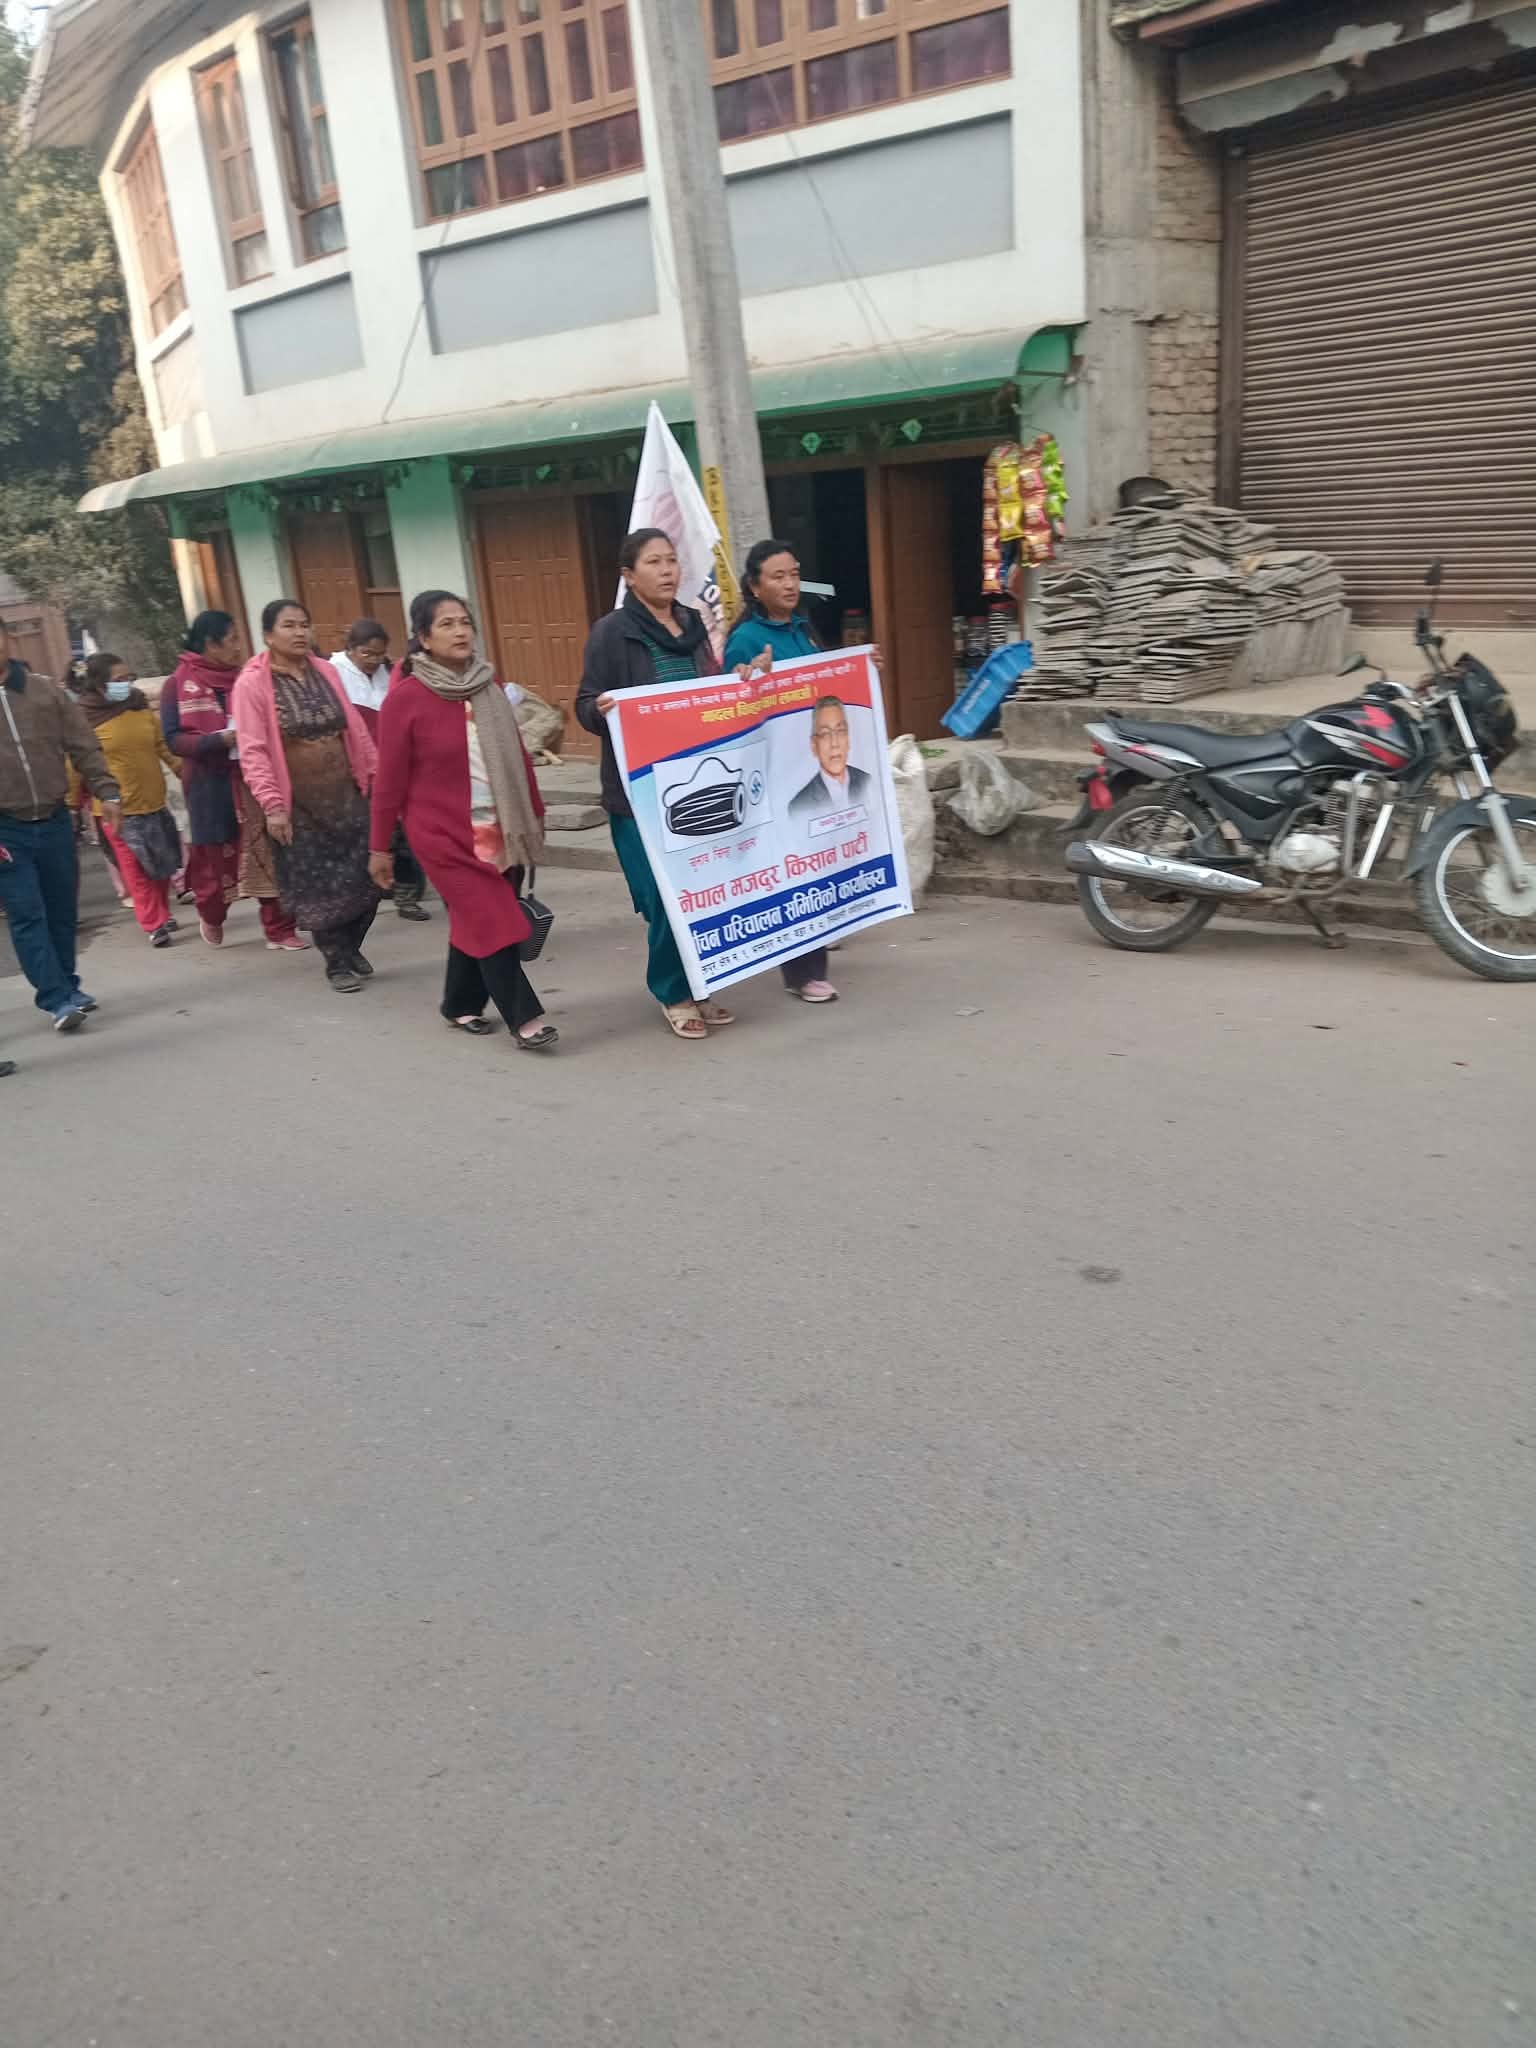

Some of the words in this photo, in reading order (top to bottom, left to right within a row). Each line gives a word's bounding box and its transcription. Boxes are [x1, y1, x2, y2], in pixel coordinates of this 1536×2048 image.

[678, 884, 726, 912] नेपाल
[730, 865, 781, 896] मजदुर
[784, 847, 838, 878] किसान
[841, 831, 868, 858] पार्टी
[722, 914, 781, 942] परिचालन
[782, 882, 837, 921] समितिको
[838, 868, 886, 899] कार्यालय
